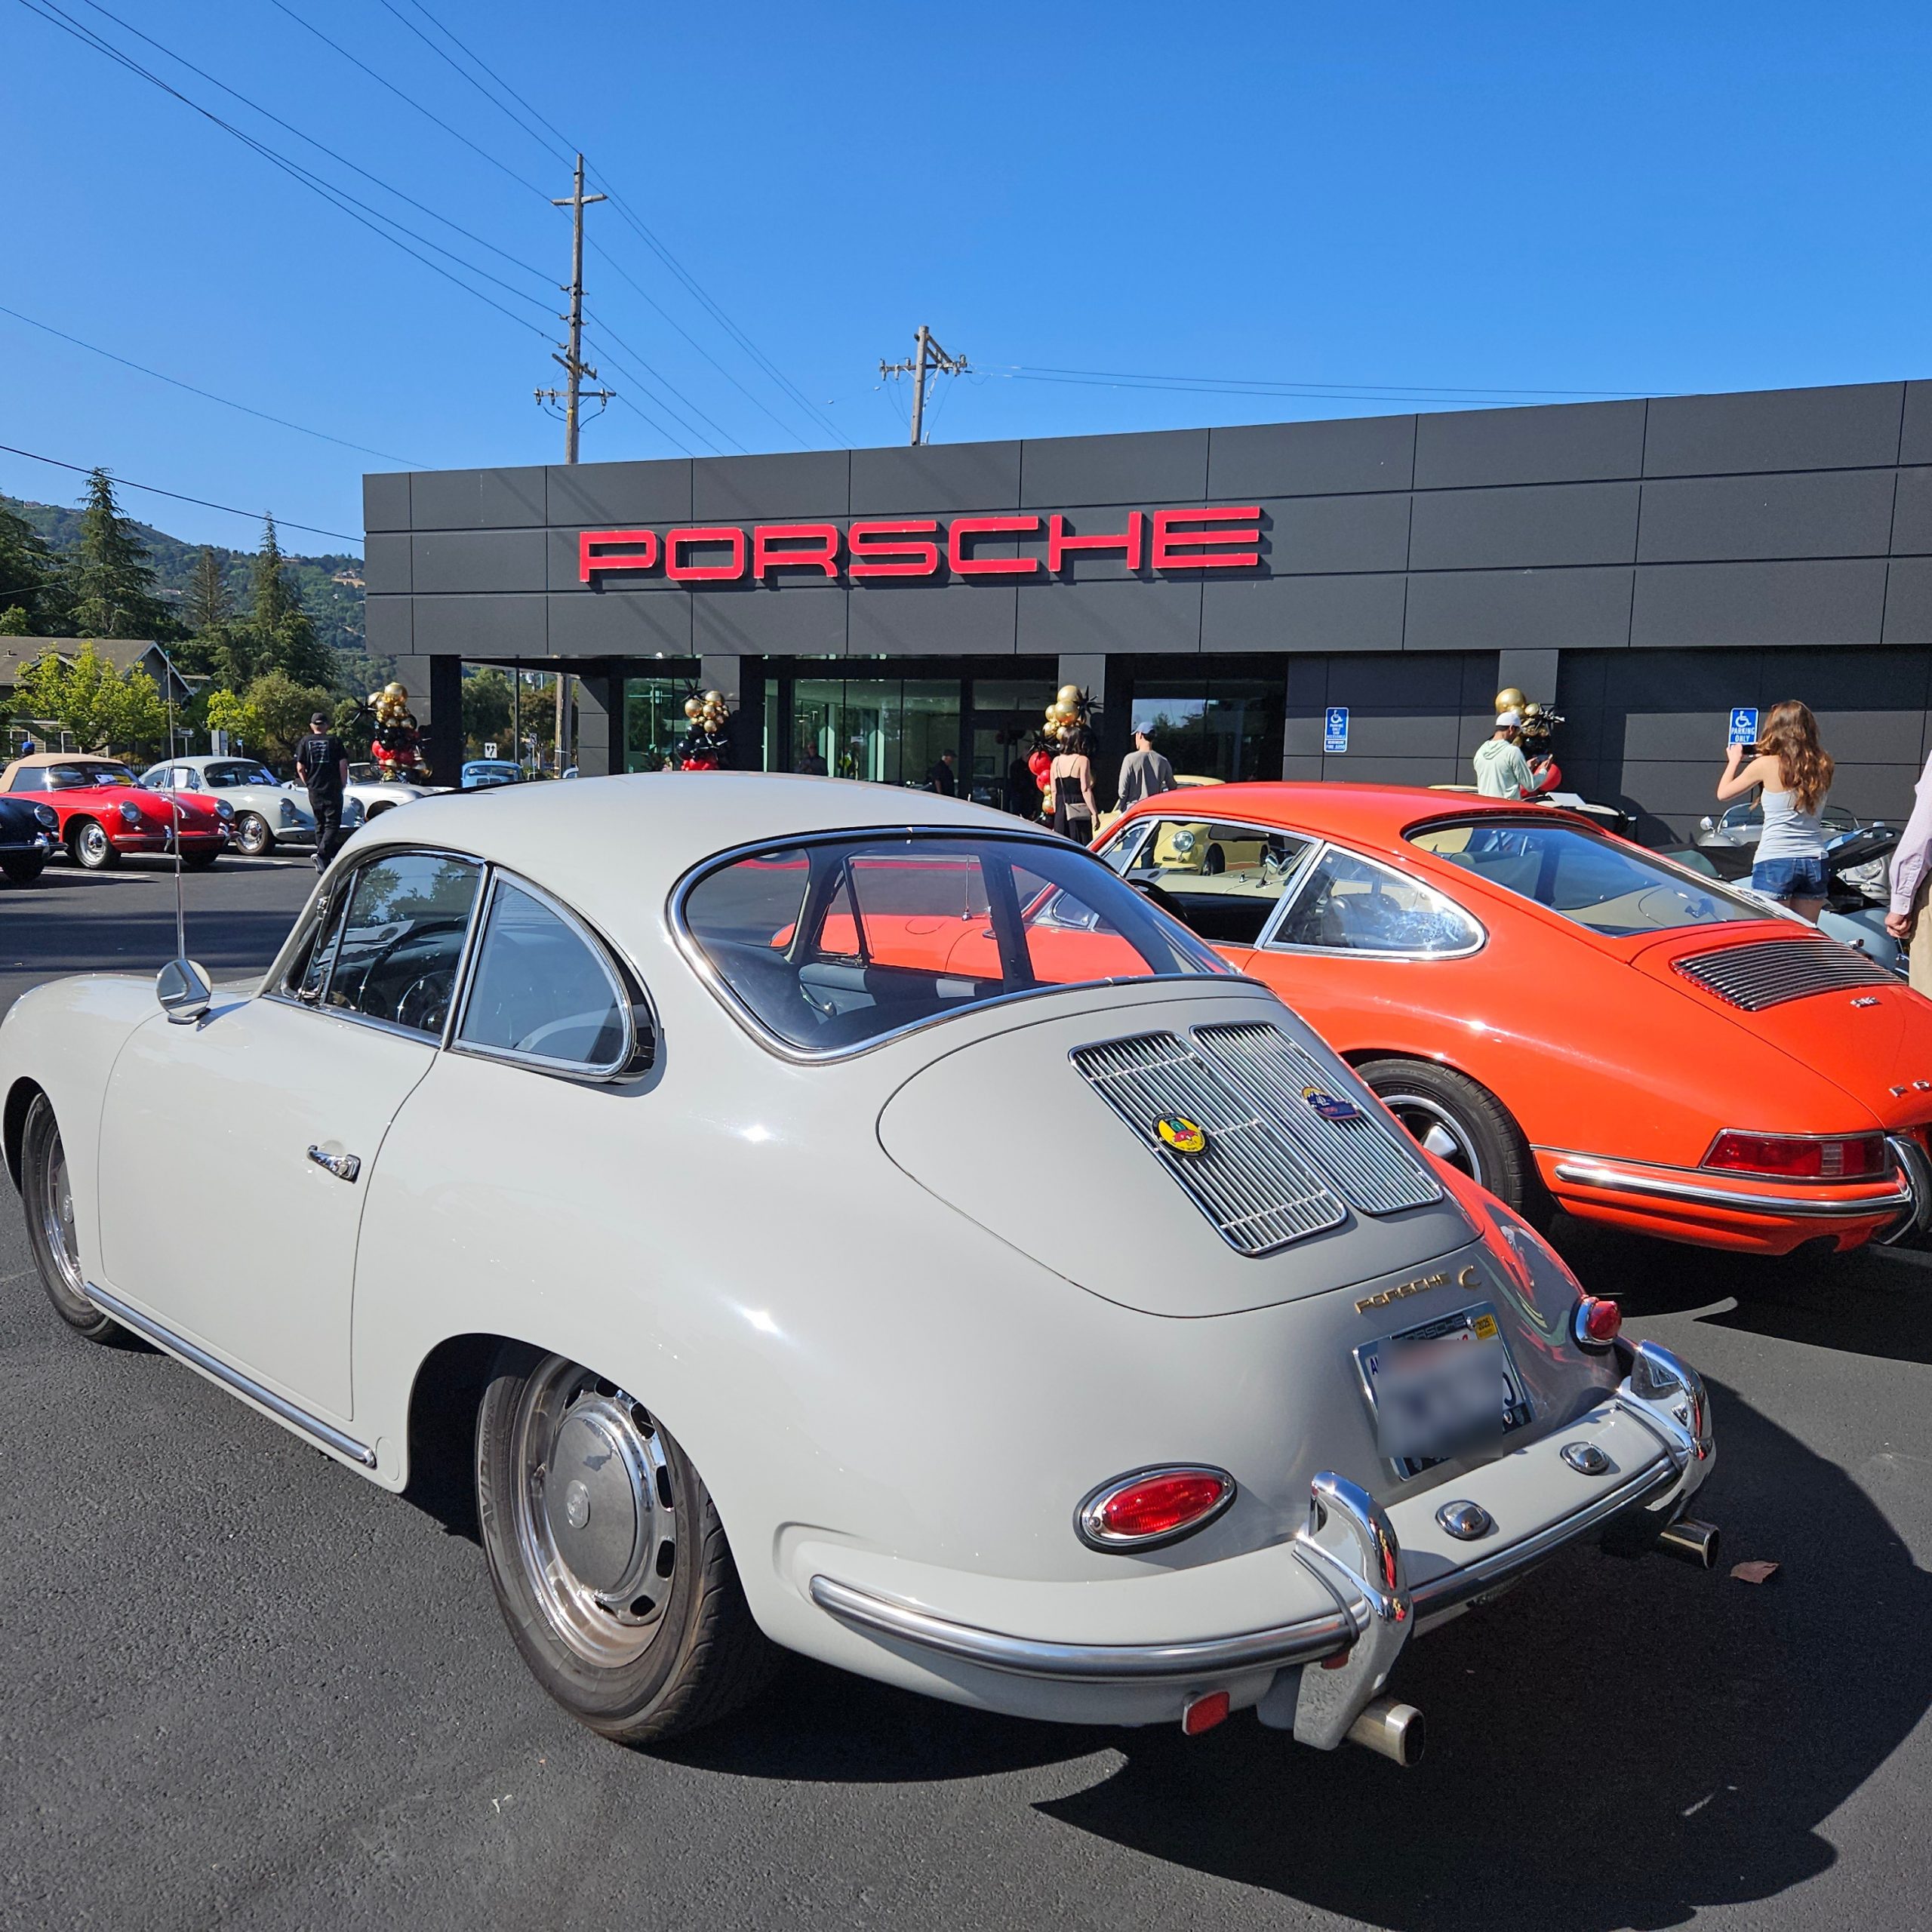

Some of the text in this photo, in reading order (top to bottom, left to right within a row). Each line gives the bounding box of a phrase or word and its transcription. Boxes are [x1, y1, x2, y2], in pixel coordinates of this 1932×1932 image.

[579, 506, 1261, 583] PORSCHE
[1731, 727, 1755, 735] PARKING
[1735, 734, 1750, 743] ONLY
[1355, 1265, 1482, 1314] PORSCHE C
